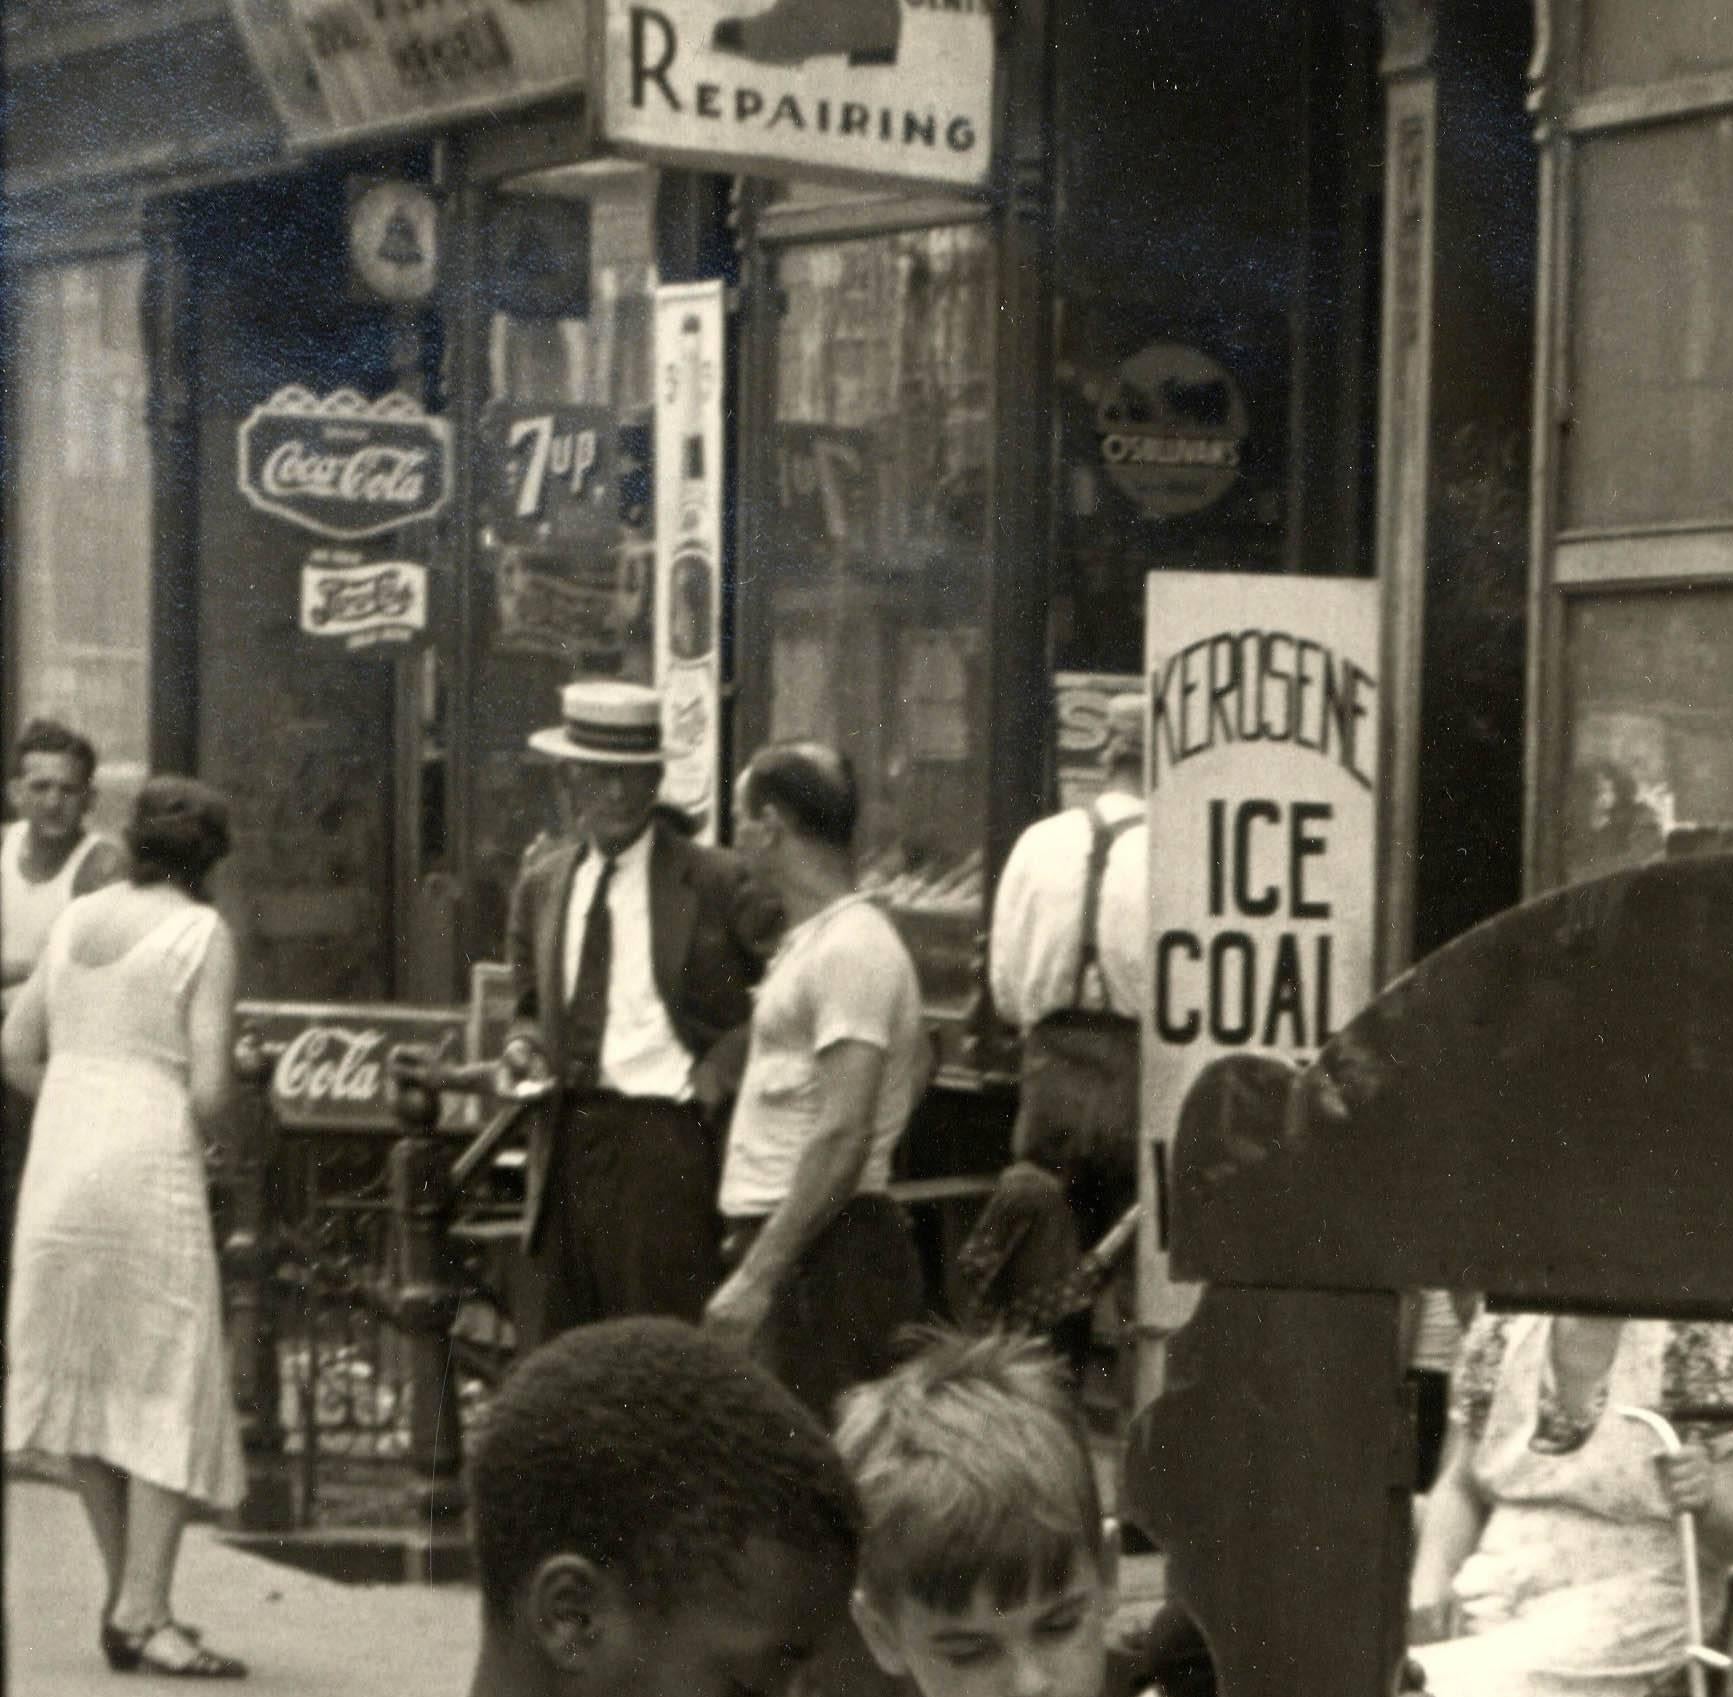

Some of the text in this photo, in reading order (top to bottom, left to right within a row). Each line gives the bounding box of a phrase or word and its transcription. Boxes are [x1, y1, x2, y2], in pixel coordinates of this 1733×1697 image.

[630, 5, 976, 153] REPAIRING
[1151, 629, 1379, 793] KEROSENE
[1208, 799, 1332, 920] ICE
[1155, 930, 1342, 1048] COAL
